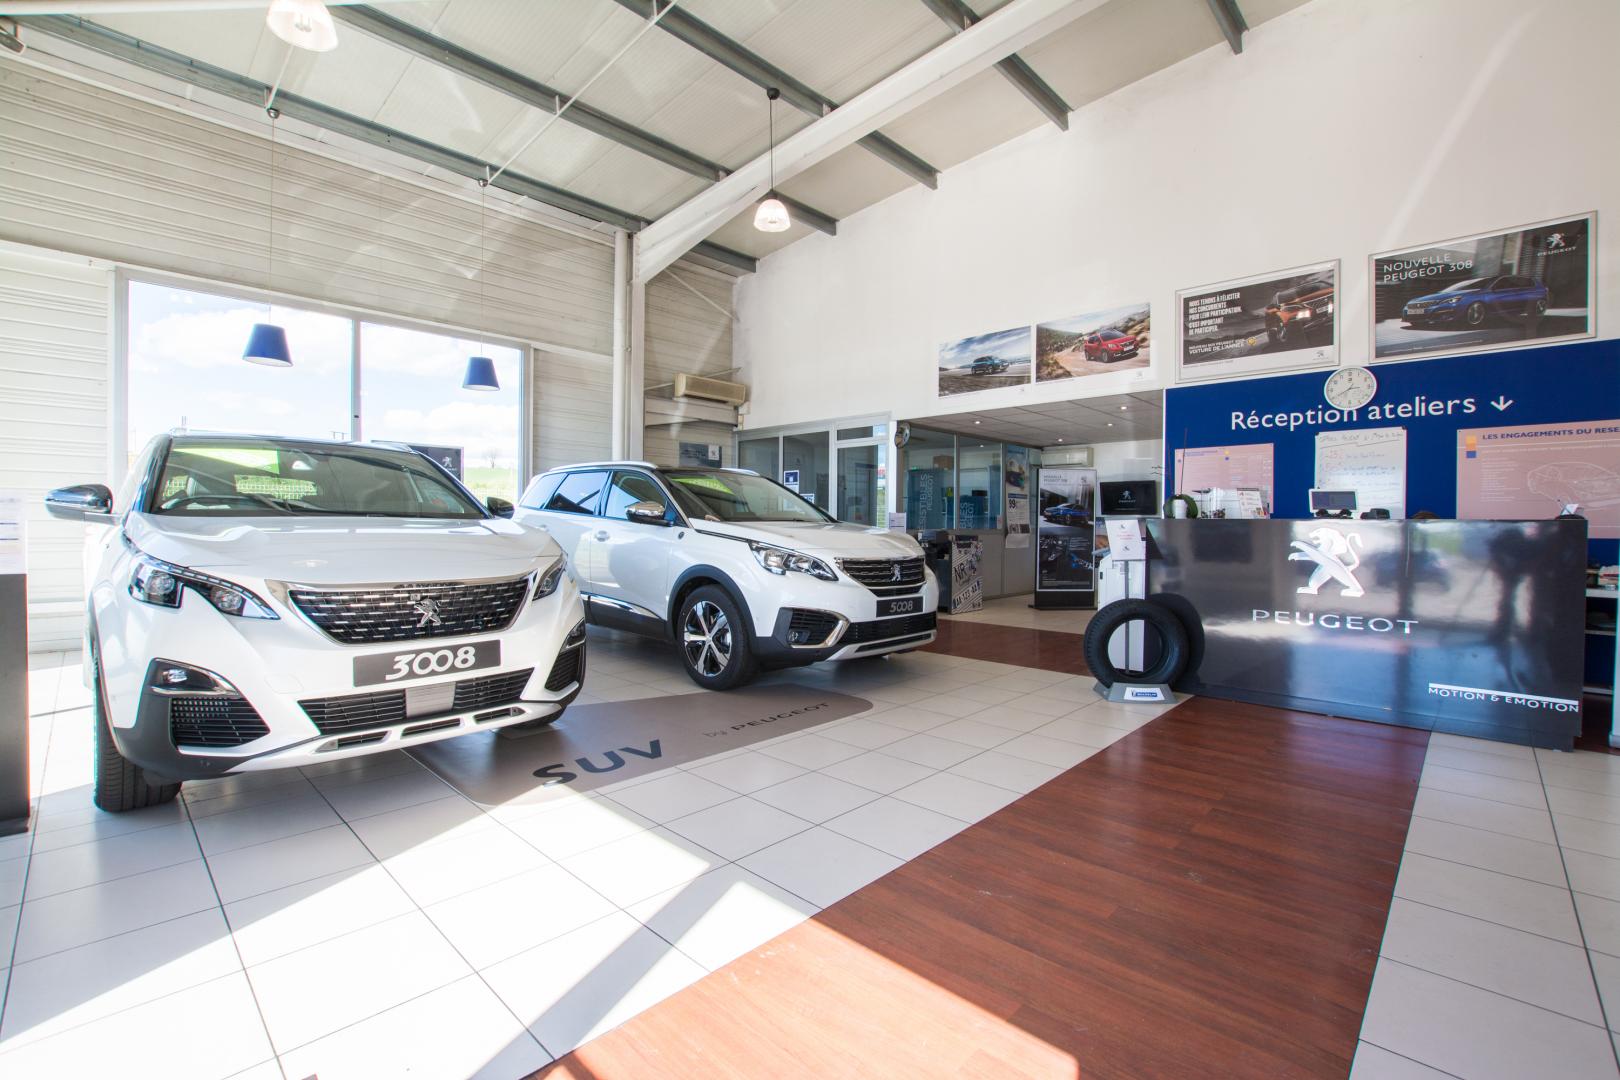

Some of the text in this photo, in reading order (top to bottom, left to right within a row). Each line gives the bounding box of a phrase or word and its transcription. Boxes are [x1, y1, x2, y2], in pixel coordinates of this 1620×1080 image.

[1384, 253, 1451, 273] NOUVELLE
[1384, 260, 1473, 284] PEUGEOT 308
[1231, 395, 1476, 431] Réception ateliers
[1501, 429, 1573, 439] ENGAGEMENTS
[889, 600, 914, 613] 5008
[1252, 609, 1419, 634] PEUGEOT
[385, 646, 476, 680] 3008
[1428, 687, 1579, 713] MOTION & EMOTION
[532, 739, 662, 787] SUV
[730, 702, 829, 731] PEUGEOT
